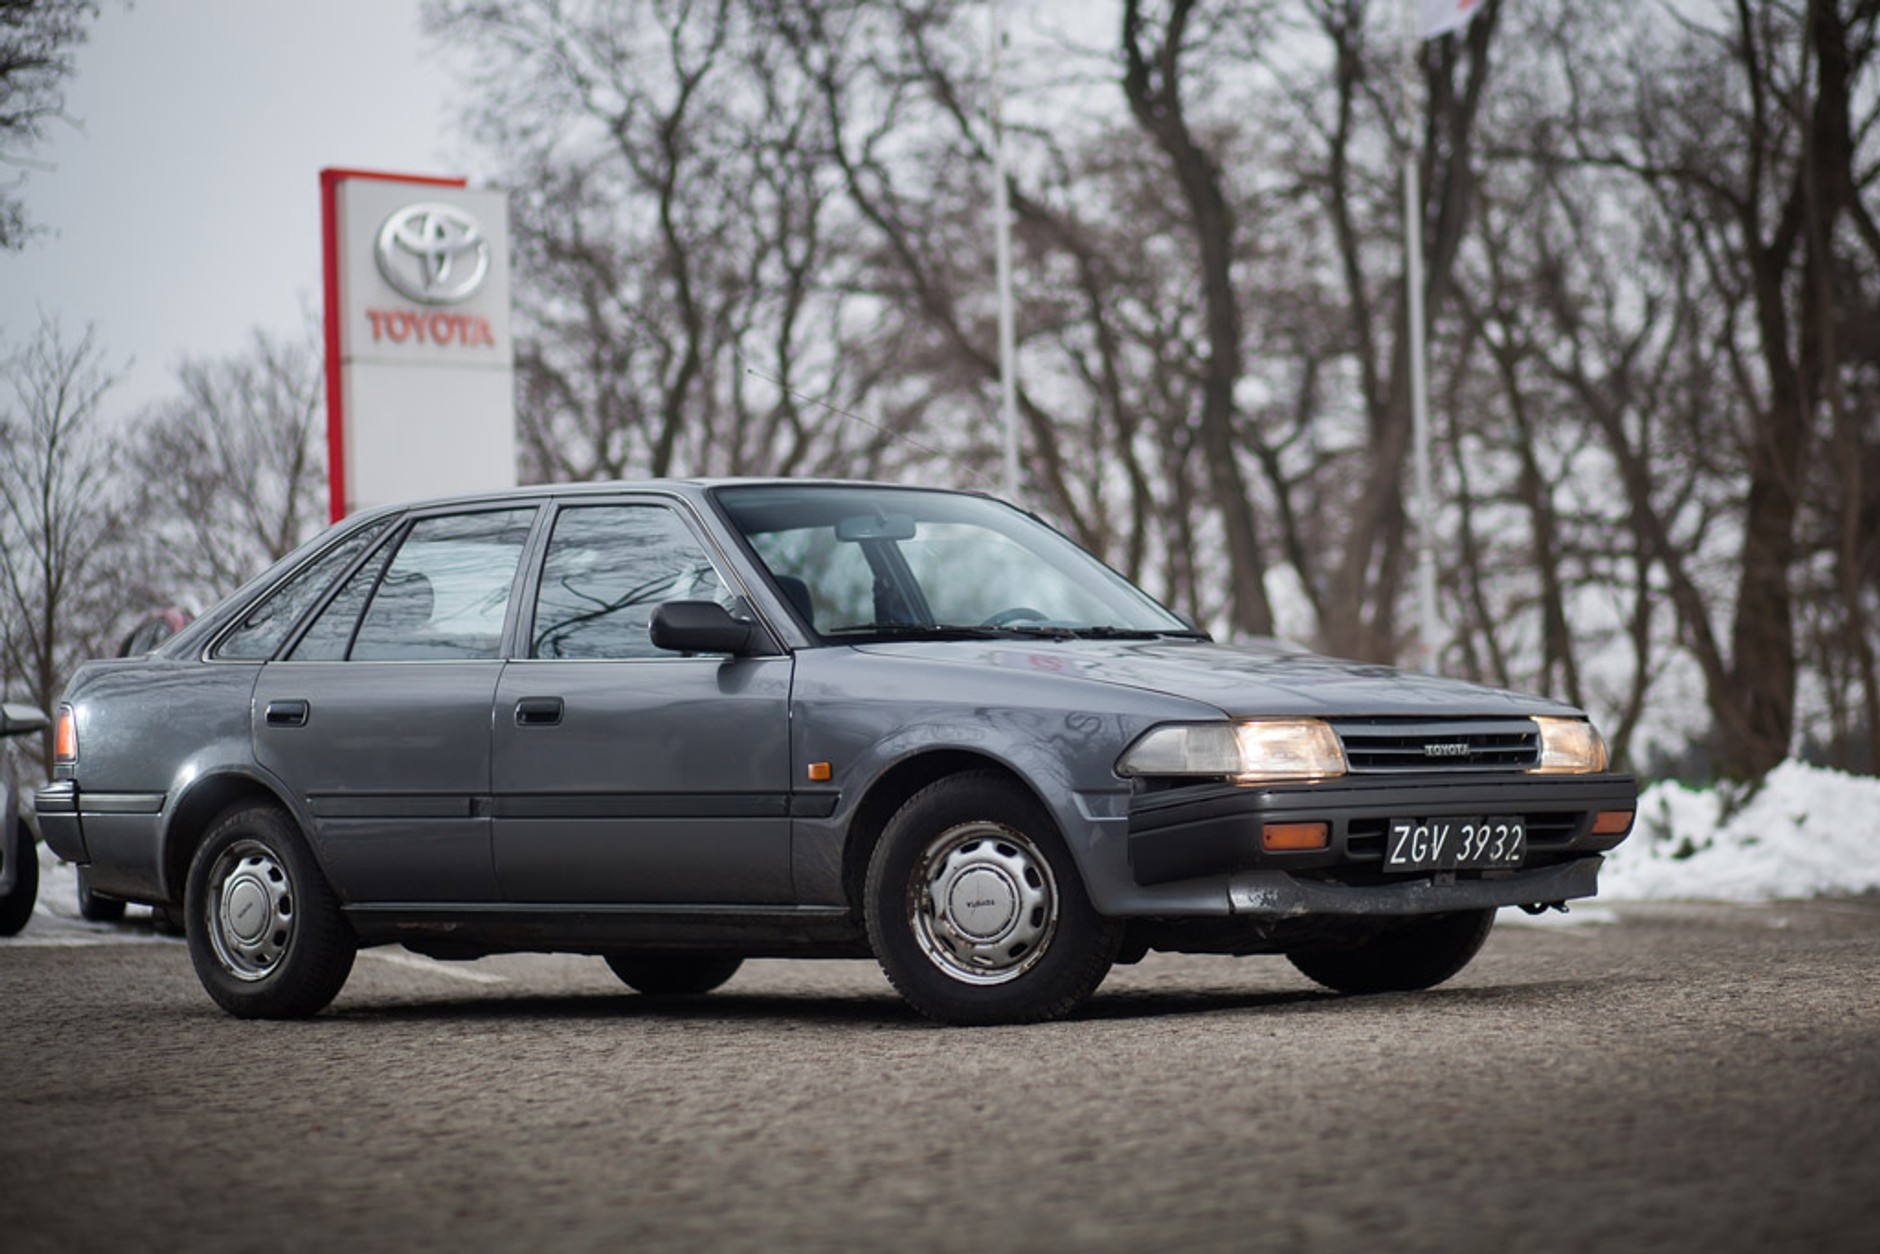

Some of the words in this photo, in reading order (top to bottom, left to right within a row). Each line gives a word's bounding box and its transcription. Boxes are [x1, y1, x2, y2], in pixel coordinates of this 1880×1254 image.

[367, 309, 495, 347] TOYOTA
[1425, 744, 1470, 756] TOYOTA
[1390, 824, 1449, 864] ZGV
[1456, 824, 1522, 861] 3932
